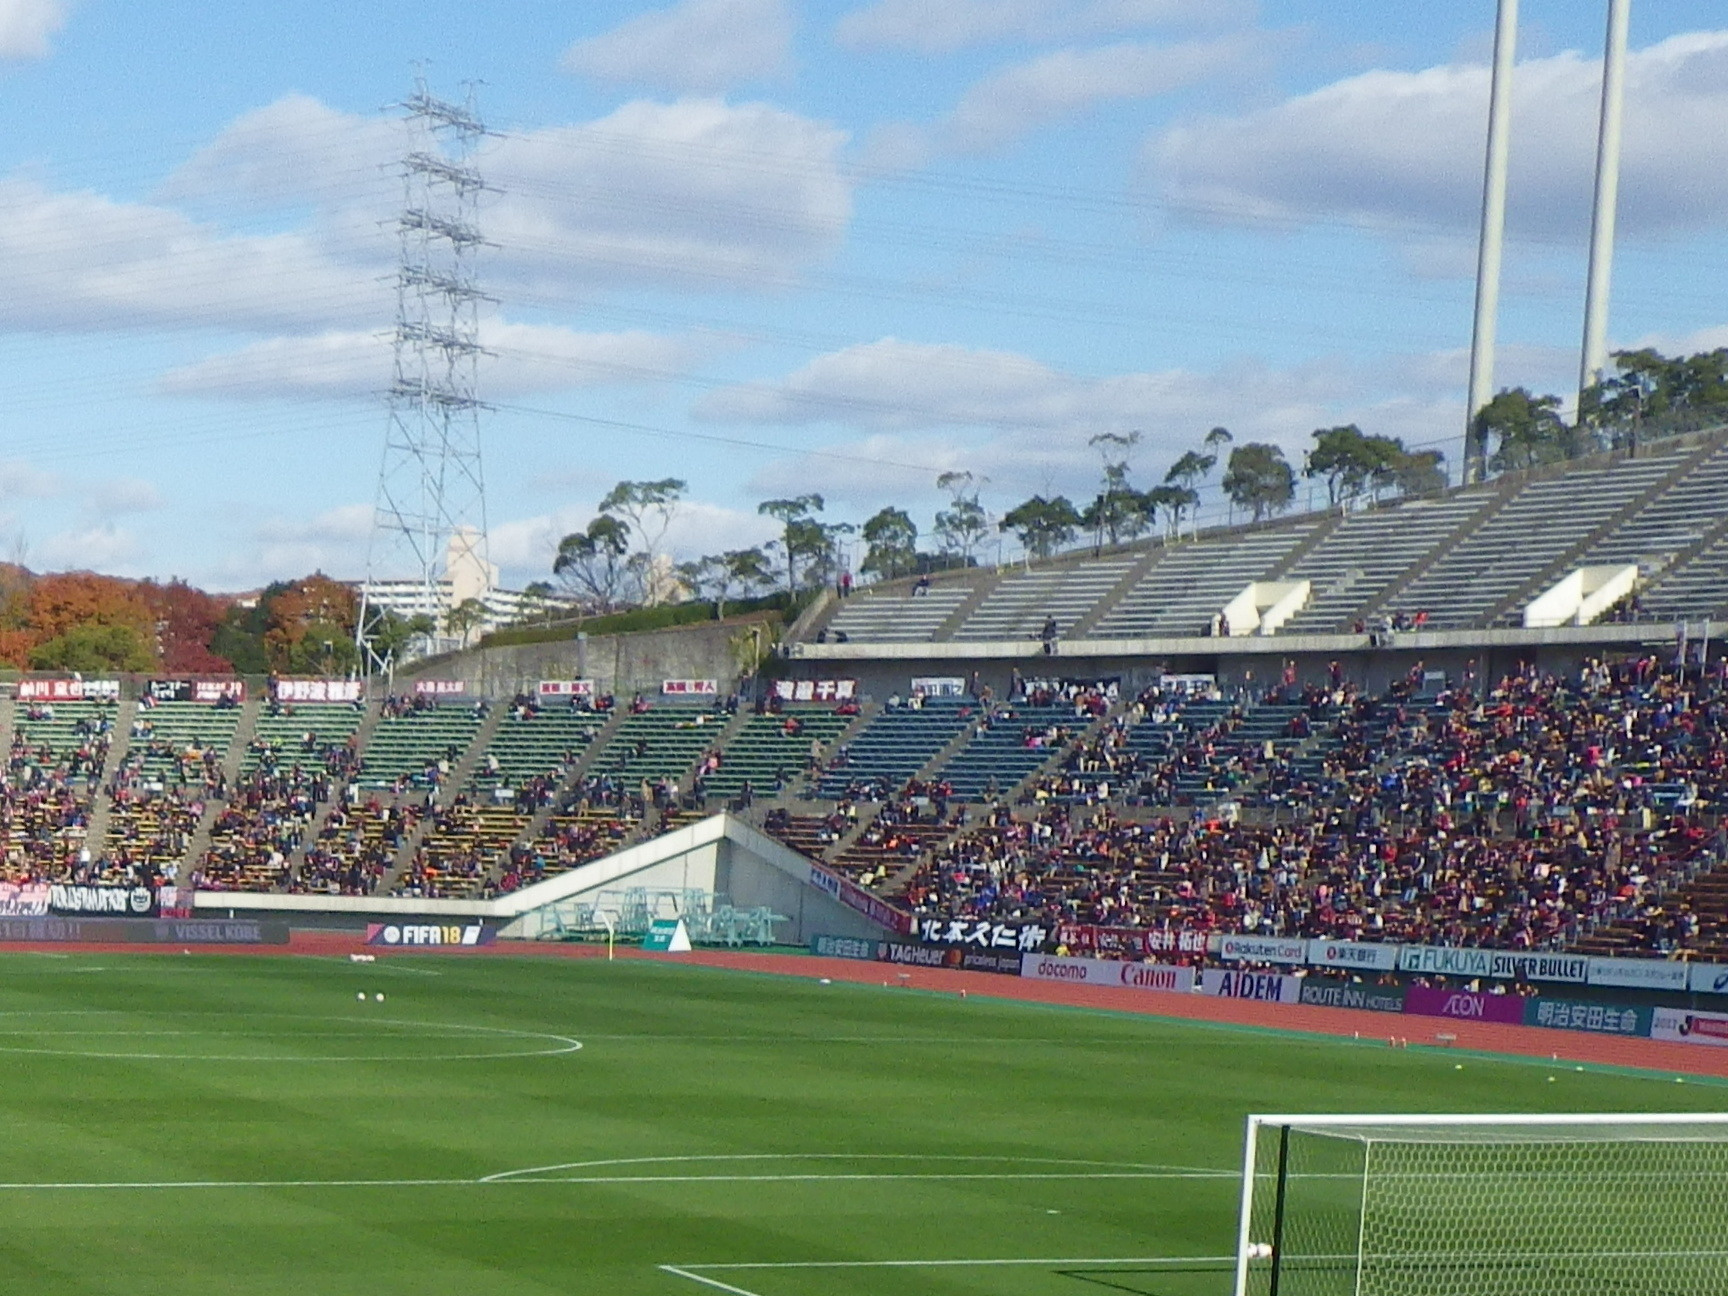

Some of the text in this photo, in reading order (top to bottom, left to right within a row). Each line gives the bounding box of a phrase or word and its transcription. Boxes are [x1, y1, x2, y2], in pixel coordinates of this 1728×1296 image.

[175, 924, 262, 941] VISSEL KOBE
[1037, 961, 1088, 980] docomo
[1422, 946, 1486, 975] FUKUYA
[1539, 959, 1585, 979] BULLET
[1120, 962, 1177, 990] Canon
[1302, 985, 1341, 1004] ROUTE
[1366, 996, 1403, 1012] HOTELS
